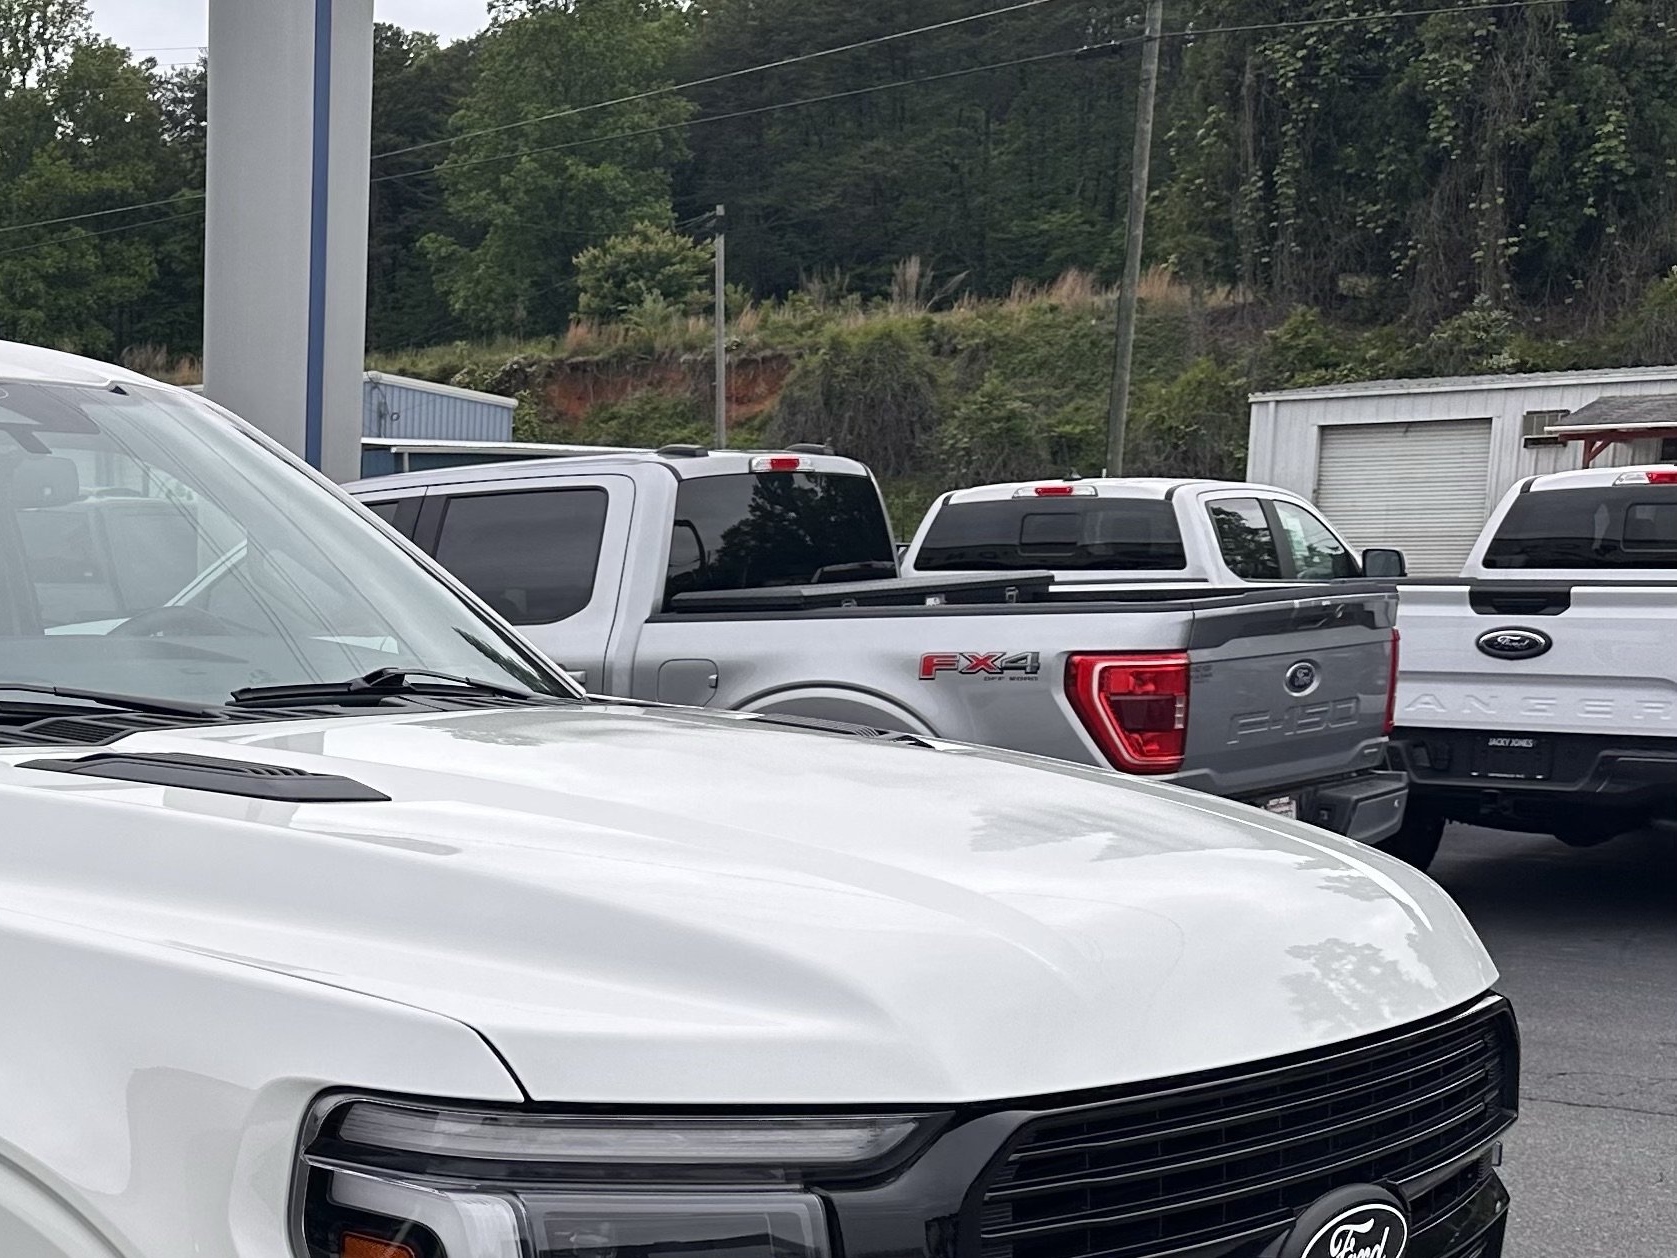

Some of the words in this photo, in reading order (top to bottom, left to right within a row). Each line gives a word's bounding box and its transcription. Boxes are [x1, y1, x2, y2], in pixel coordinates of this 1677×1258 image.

[918, 650, 1041, 677] FX4
[1403, 692, 1673, 720] ANGER
[1226, 696, 1361, 745] F-150
